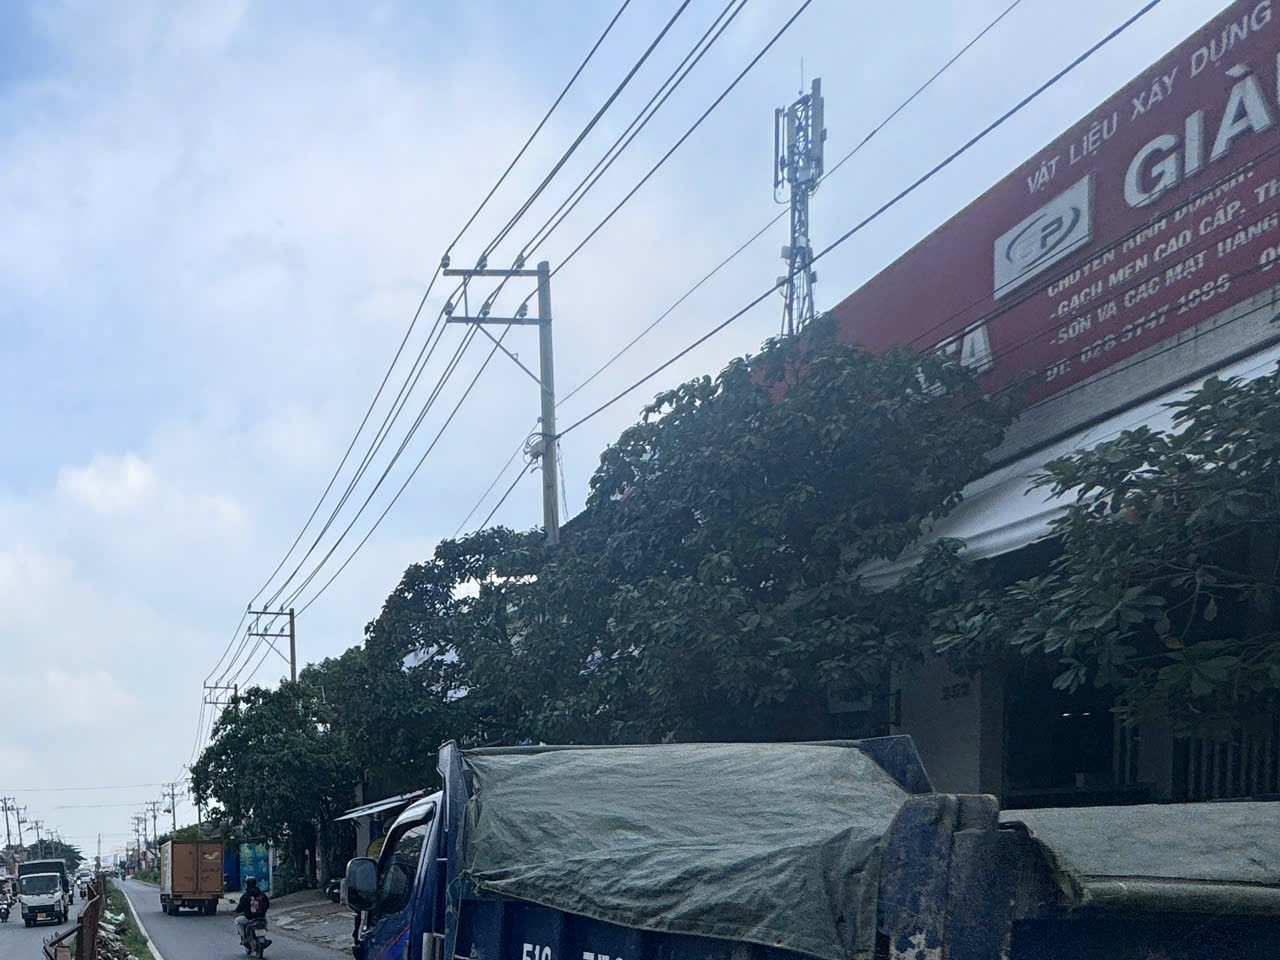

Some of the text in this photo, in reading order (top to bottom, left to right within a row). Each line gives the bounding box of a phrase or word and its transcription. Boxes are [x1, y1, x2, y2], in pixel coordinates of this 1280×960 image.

[1026, 0, 1273, 195] VẬT LIỆU XÂY DỰNG
[1123, 52, 1280, 208] GIÀ
[1108, 254, 1148, 288] MEN
[1153, 230, 1192, 263] CAO
[1122, 214, 1167, 253] KINH
[1218, 212, 1279, 258] HÀNG
